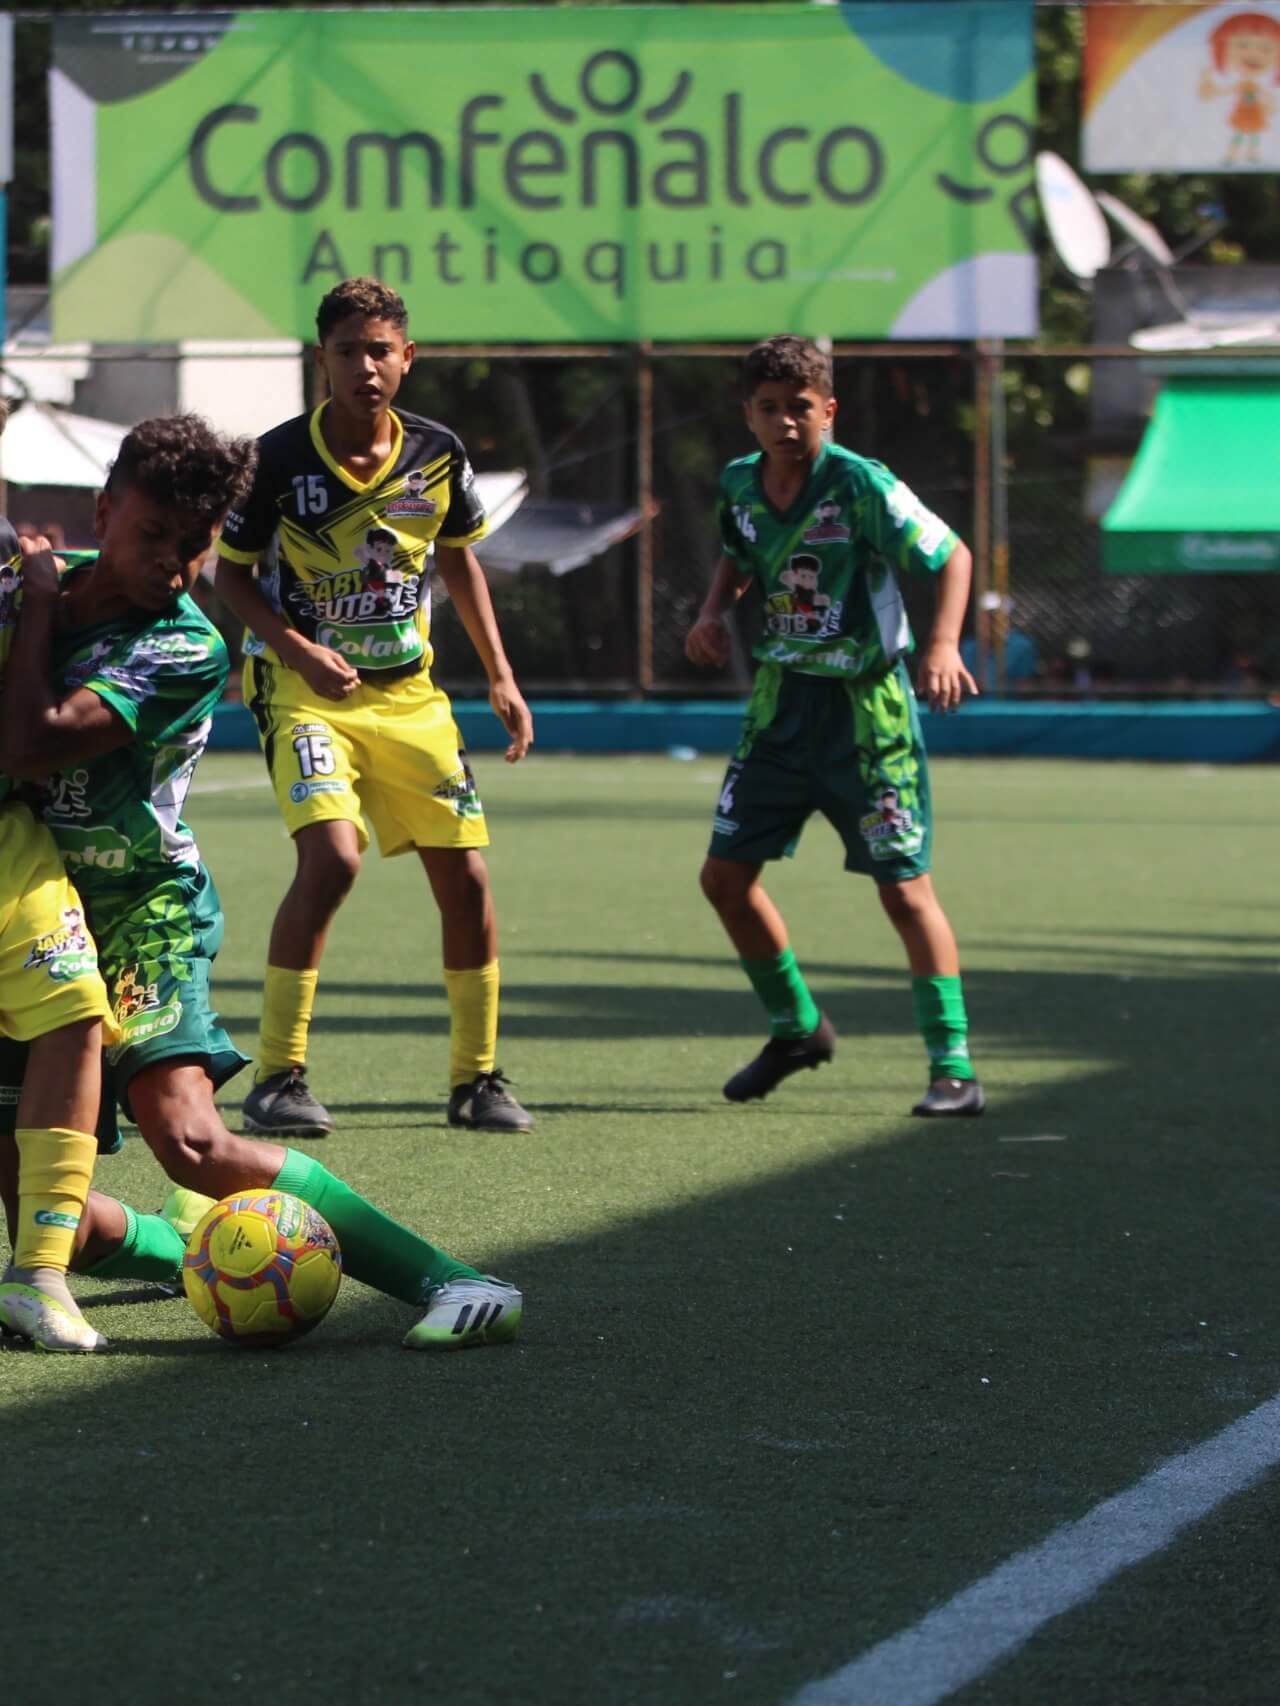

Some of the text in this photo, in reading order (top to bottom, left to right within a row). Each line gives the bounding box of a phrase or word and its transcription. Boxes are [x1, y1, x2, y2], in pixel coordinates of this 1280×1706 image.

[187, 90, 885, 212] Comfenalco
[298, 227, 788, 298] Antioquia
[292, 474, 329, 517] 15
[293, 735, 337, 778] 15
